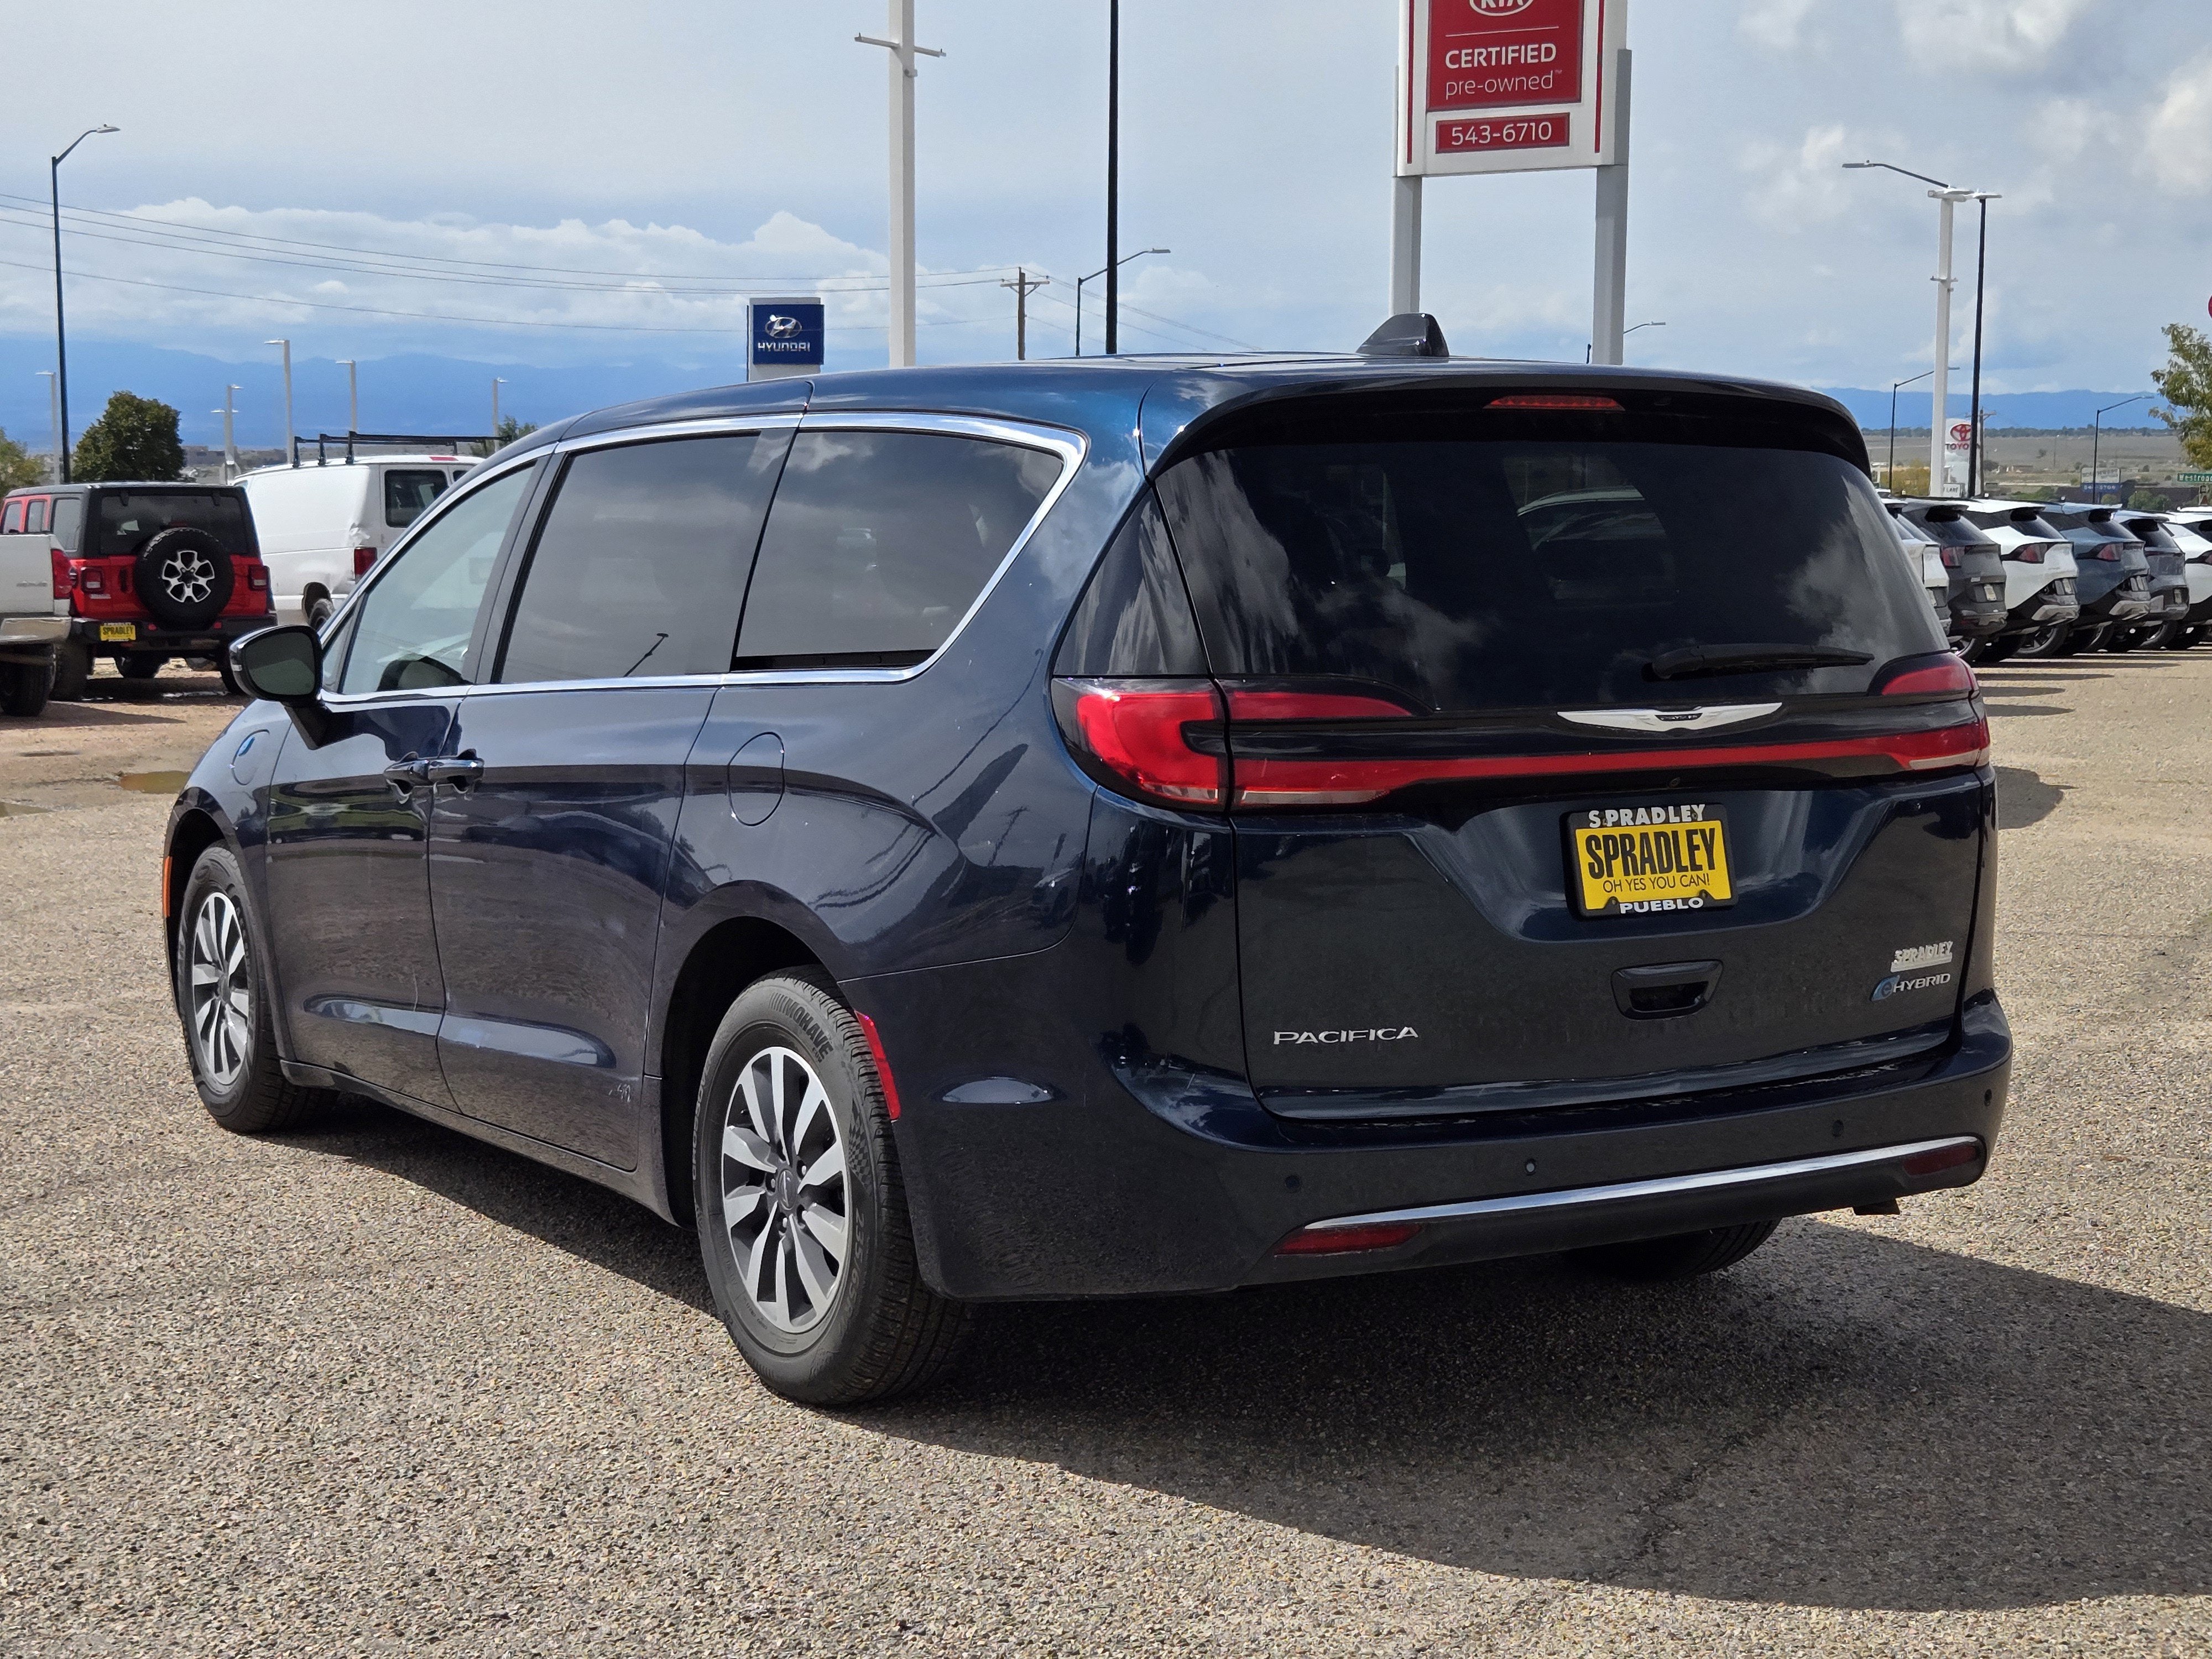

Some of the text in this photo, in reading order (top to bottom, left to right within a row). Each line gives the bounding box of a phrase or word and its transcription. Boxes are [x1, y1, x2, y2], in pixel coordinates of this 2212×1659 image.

[1445, 43, 1557, 69] CERTIFIED
[1451, 121, 1552, 145] 543-6710
[758, 342, 811, 352] HYUNDAI
[103, 626, 134, 635] SPRADLEY
[1588, 804, 1705, 828] SPRADLEY
[1585, 827, 1716, 880] SPRADLEY
[1603, 873, 1710, 893] OH YES YOU CAN!
[1619, 897, 1704, 914] PUEBLO
[783, 998, 834, 1060] MOHAVE
[1273, 1026, 1419, 1045] PACIFICA
